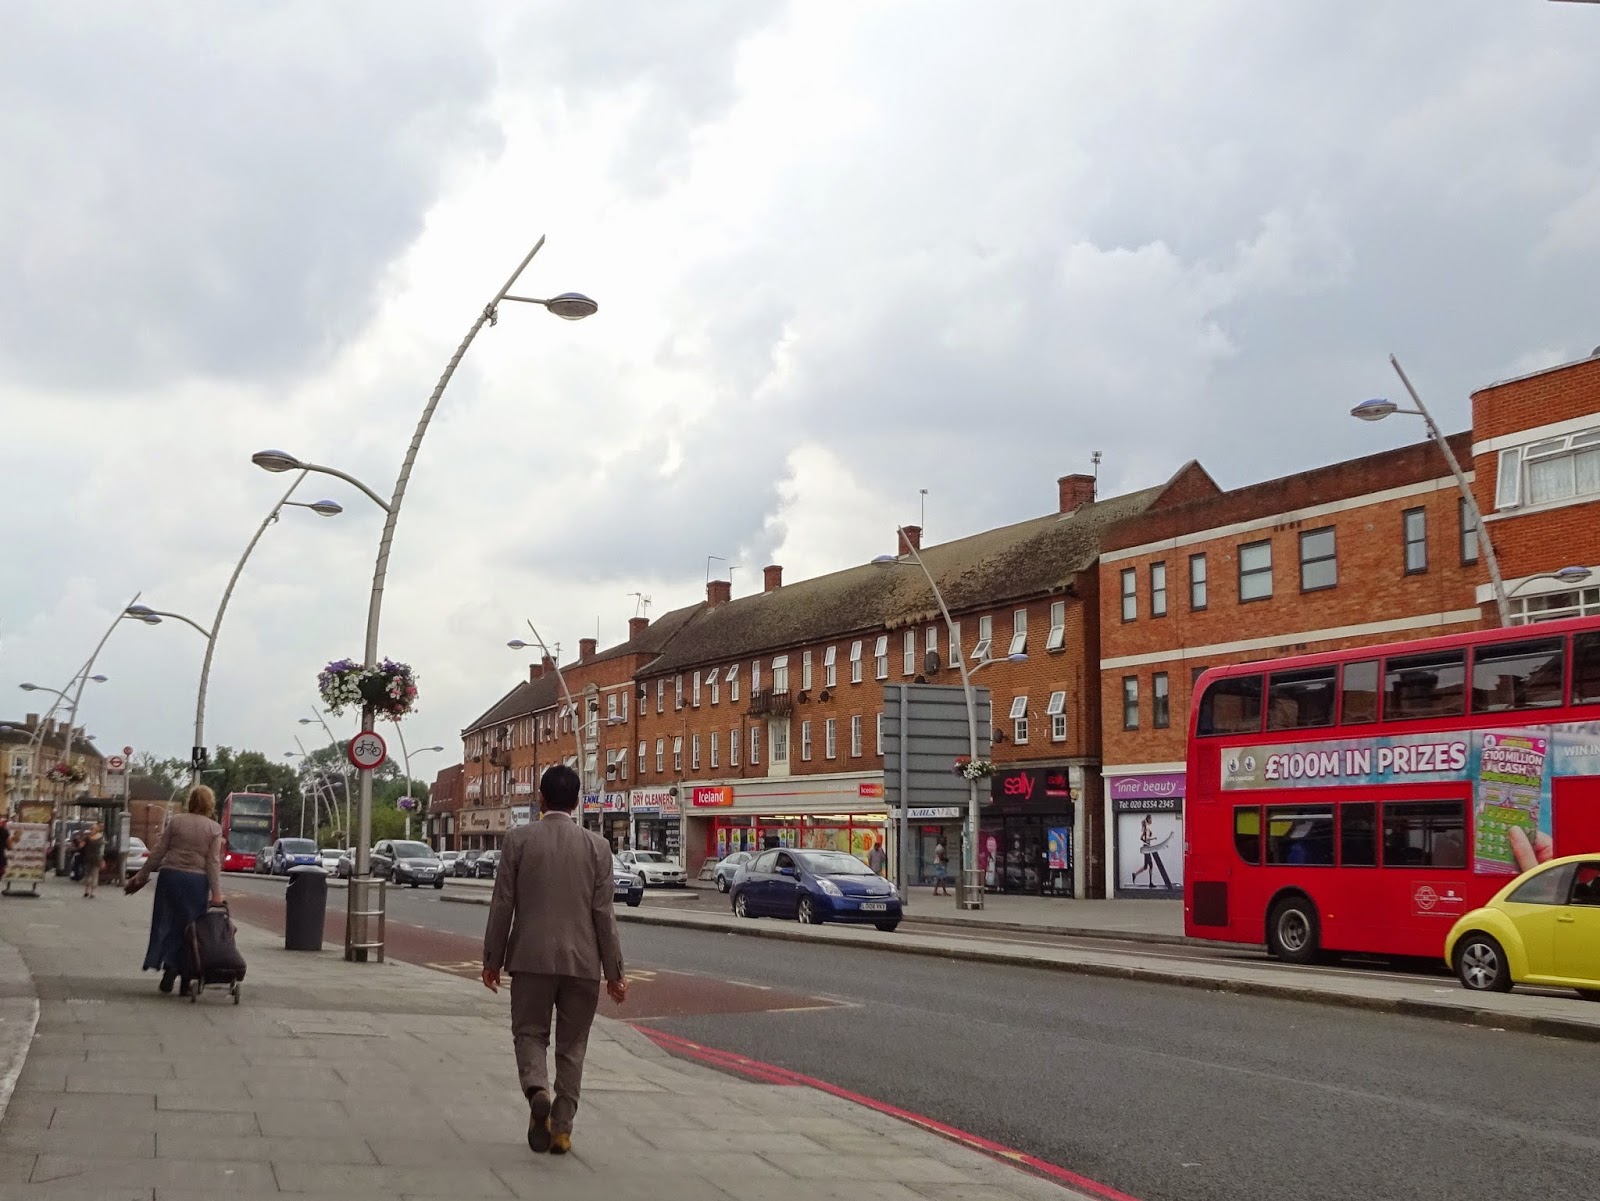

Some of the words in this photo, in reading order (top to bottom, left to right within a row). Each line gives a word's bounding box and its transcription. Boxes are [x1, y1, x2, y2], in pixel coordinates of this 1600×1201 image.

[1564, 745, 1588, 757] WIN
[1264, 750, 1340, 780] £100M
[1345, 748, 1371, 776] IN
[1377, 742, 1467, 774] PRIZES
[1483, 750, 1505, 761] £100
[1505, 752, 1542, 766] MILLION
[1498, 762, 1526, 775] CASH
[1004, 771, 1035, 800] sally
[1118, 781, 1141, 793] inner
[1142, 780, 1177, 795] beauty
[632, 794, 643, 806] DRY
[644, 792, 673, 806] CLEANERS
[698, 790, 724, 803] Iceland
[1142, 801, 1158, 809] 8554
[1158, 800, 1175, 808] 2345
[911, 808, 936, 817] NAILS
